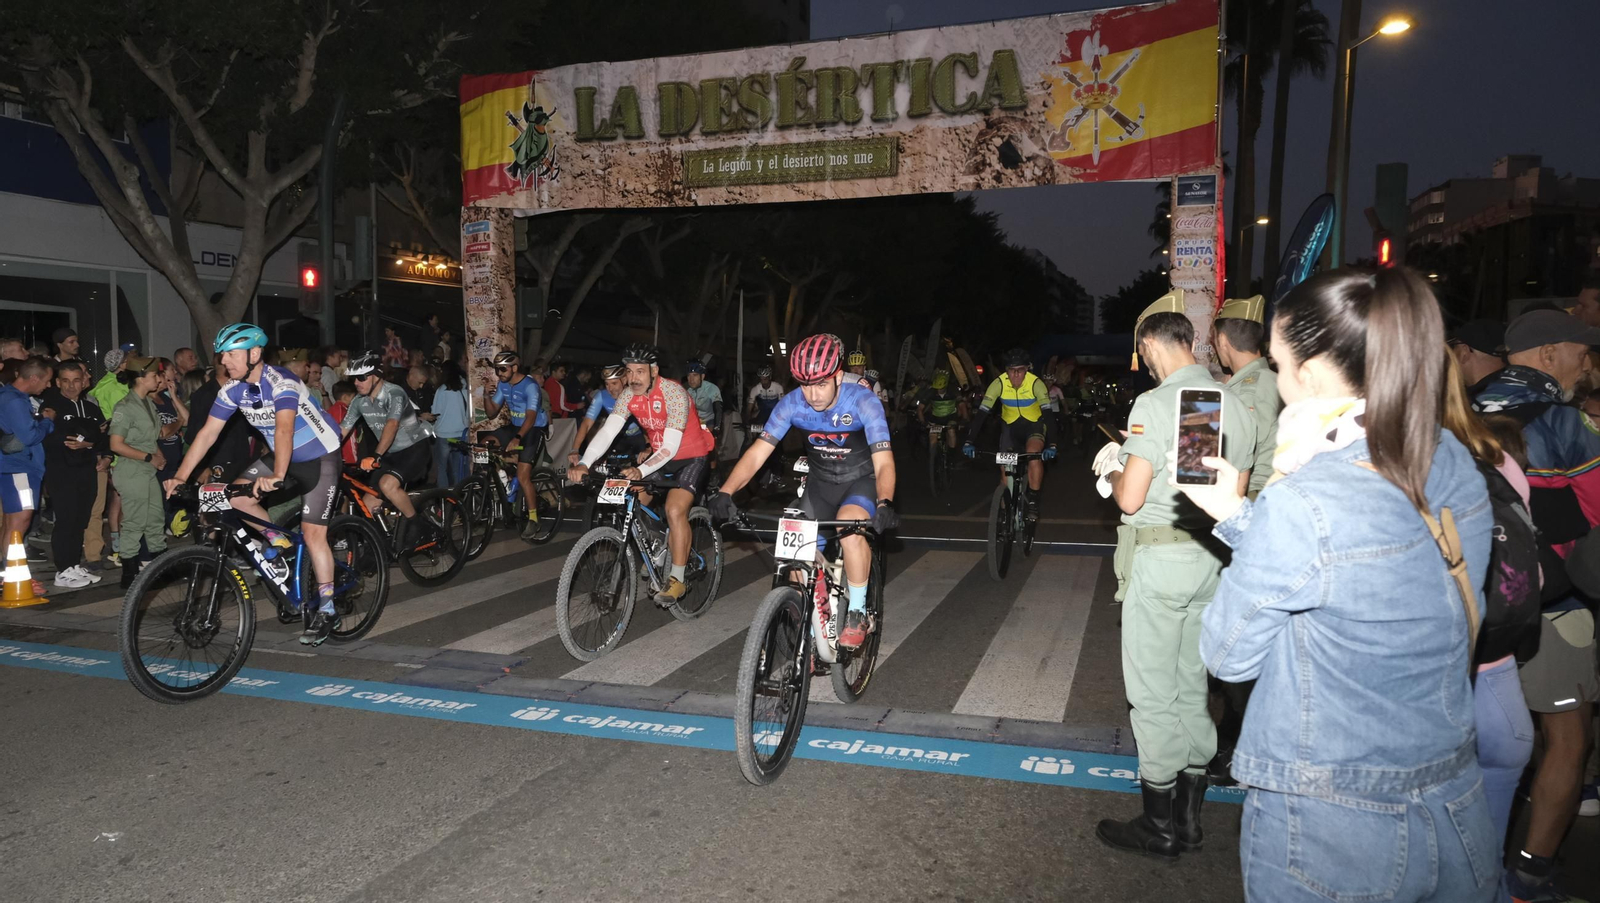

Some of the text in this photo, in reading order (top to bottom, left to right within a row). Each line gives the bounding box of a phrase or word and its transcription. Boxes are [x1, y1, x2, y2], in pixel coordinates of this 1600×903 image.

[574, 49, 1029, 140] LA DESÉRTICA
[703, 152, 873, 175] La Legión y el desierto nos une
[1176, 246, 1213, 256] RENTA
[240, 408, 276, 423] eynold
[603, 486, 624, 497] 7602
[321, 485, 336, 520] Reynolds
[782, 531, 805, 548] 629
[231, 569, 250, 600] MAXXIS
[10, 651, 111, 666] cajamar
[351, 691, 477, 710] cajamar
[562, 715, 705, 735] cajamar
[653, 731, 690, 740] RURAL
[808, 739, 971, 762] cajamar
[918, 758, 961, 767] RURAL
